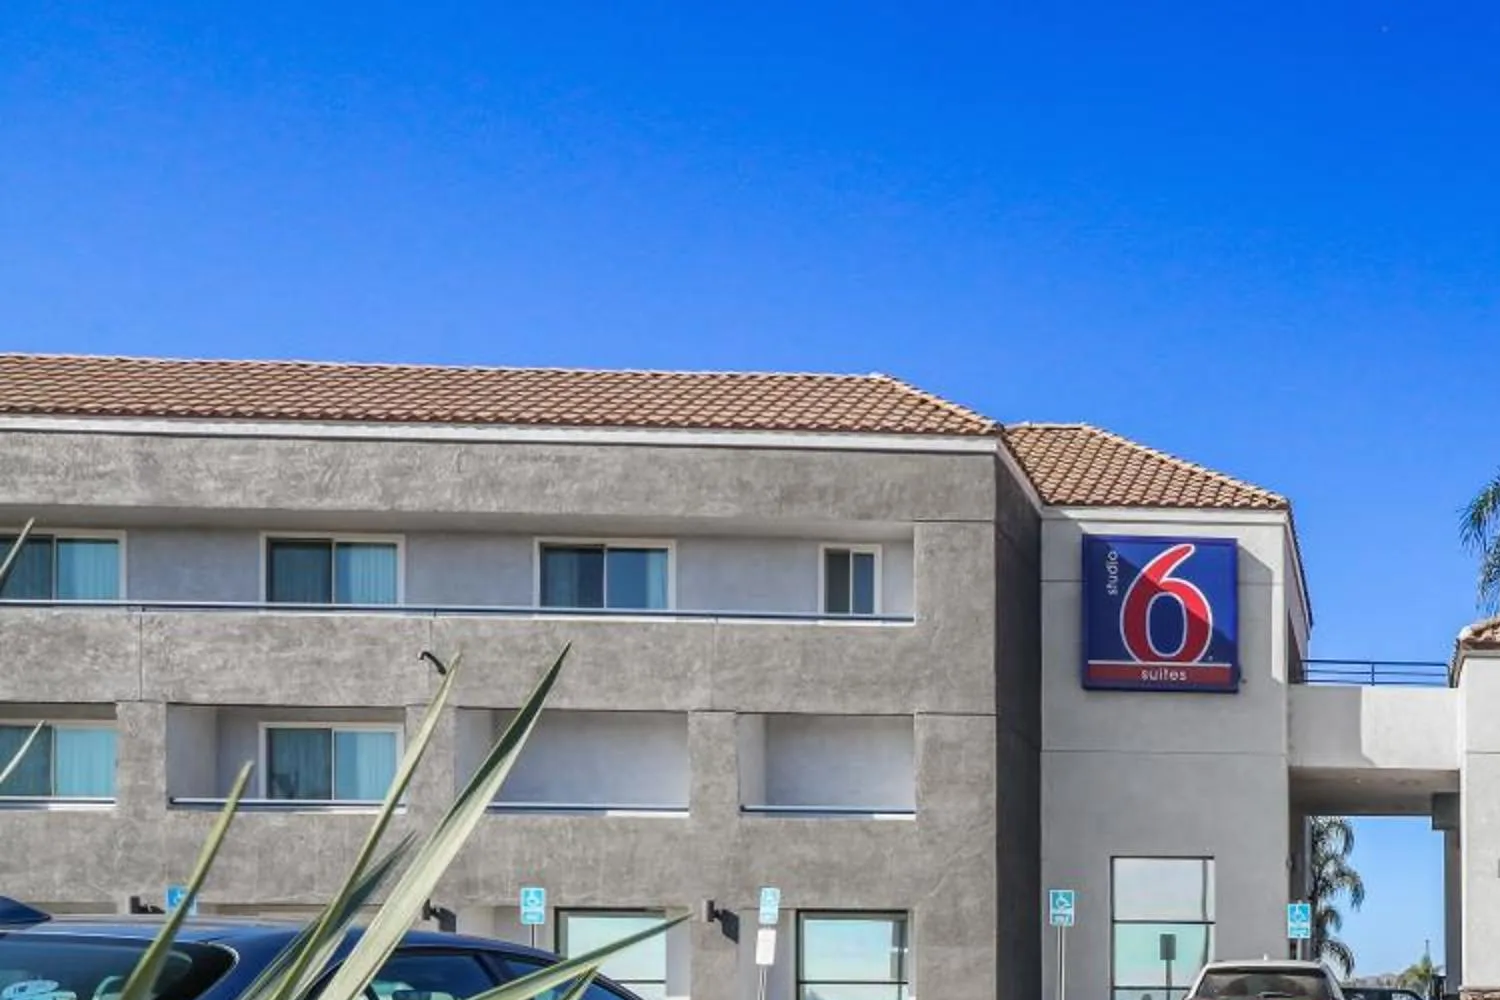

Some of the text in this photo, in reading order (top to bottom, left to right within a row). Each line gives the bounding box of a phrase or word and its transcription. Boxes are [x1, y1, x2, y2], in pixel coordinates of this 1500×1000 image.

[1106, 551, 1118, 595] studio
[1120, 544, 1213, 665] 6
[1141, 668, 1187, 681] suites
